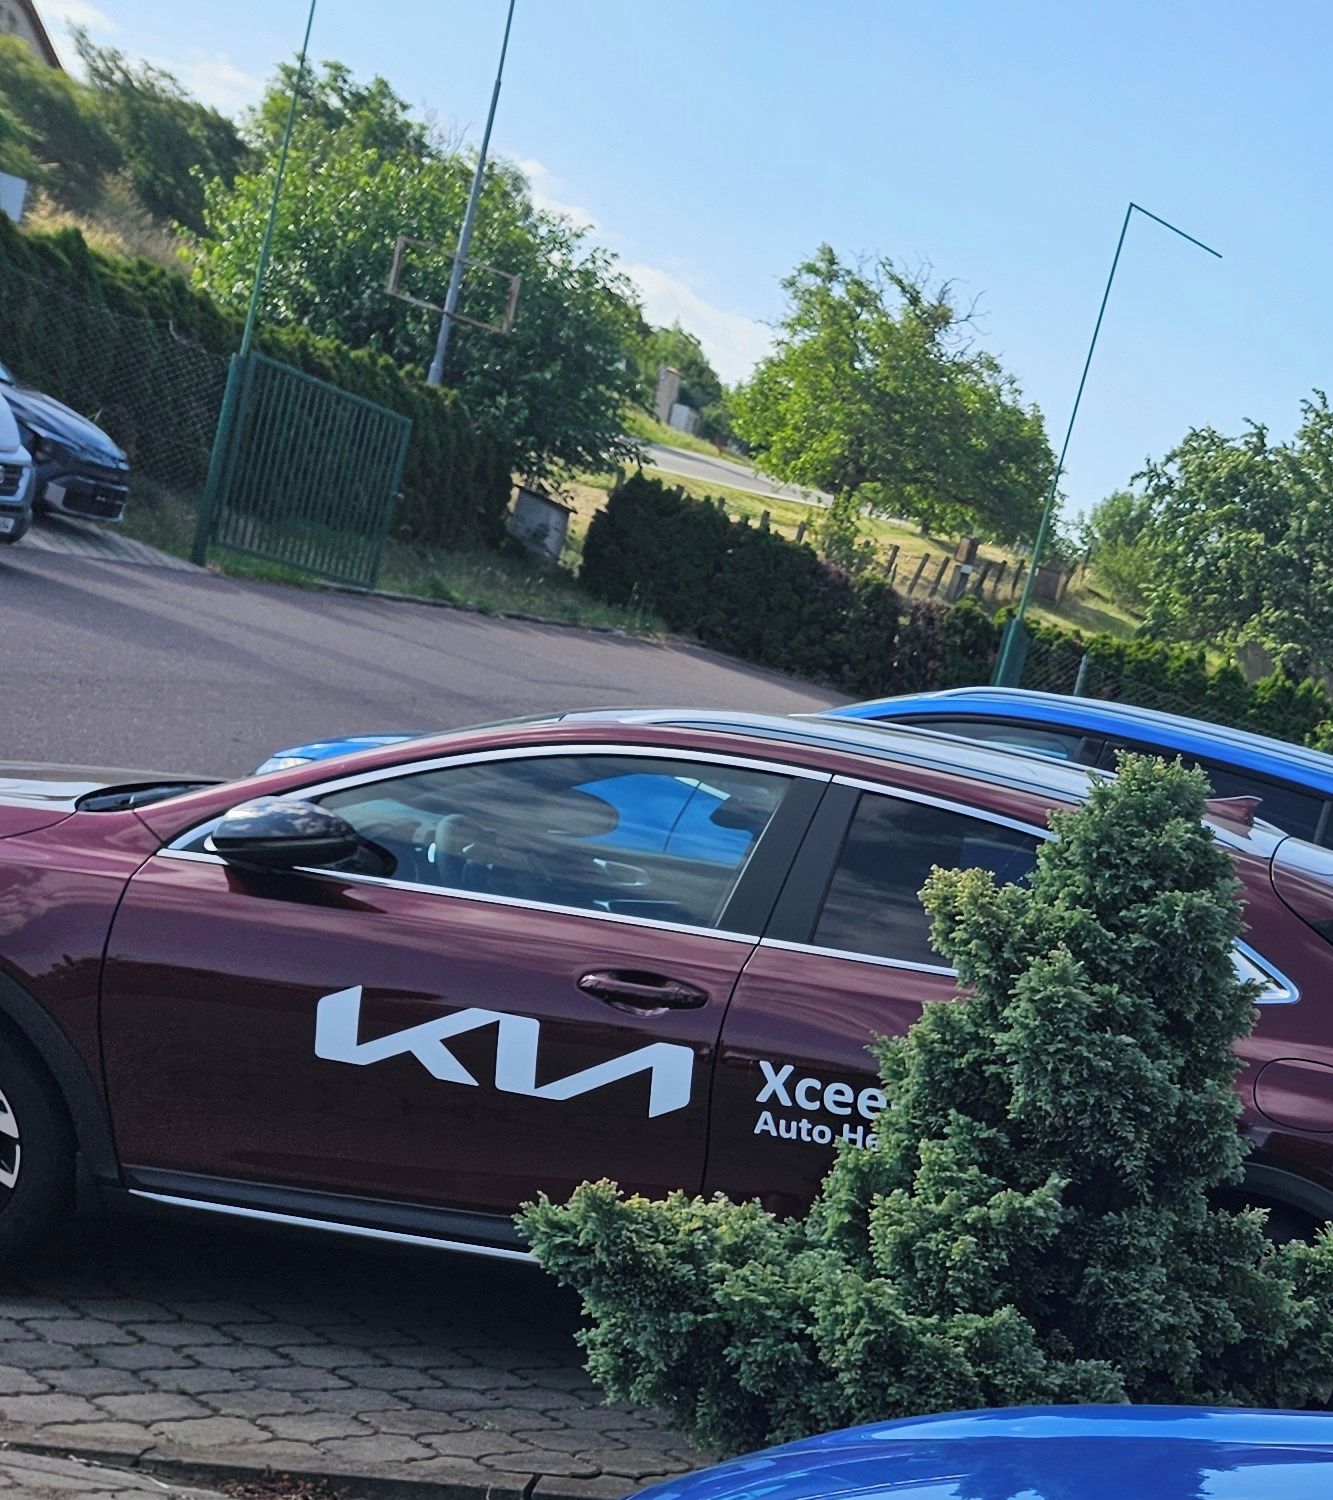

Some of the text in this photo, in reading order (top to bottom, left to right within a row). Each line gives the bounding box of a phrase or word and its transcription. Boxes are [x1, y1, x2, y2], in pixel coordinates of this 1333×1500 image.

[314, 985, 694, 1118] KIA
[755, 1060, 897, 1121] Xcee
[753, 1111, 882, 1152] Auto He
